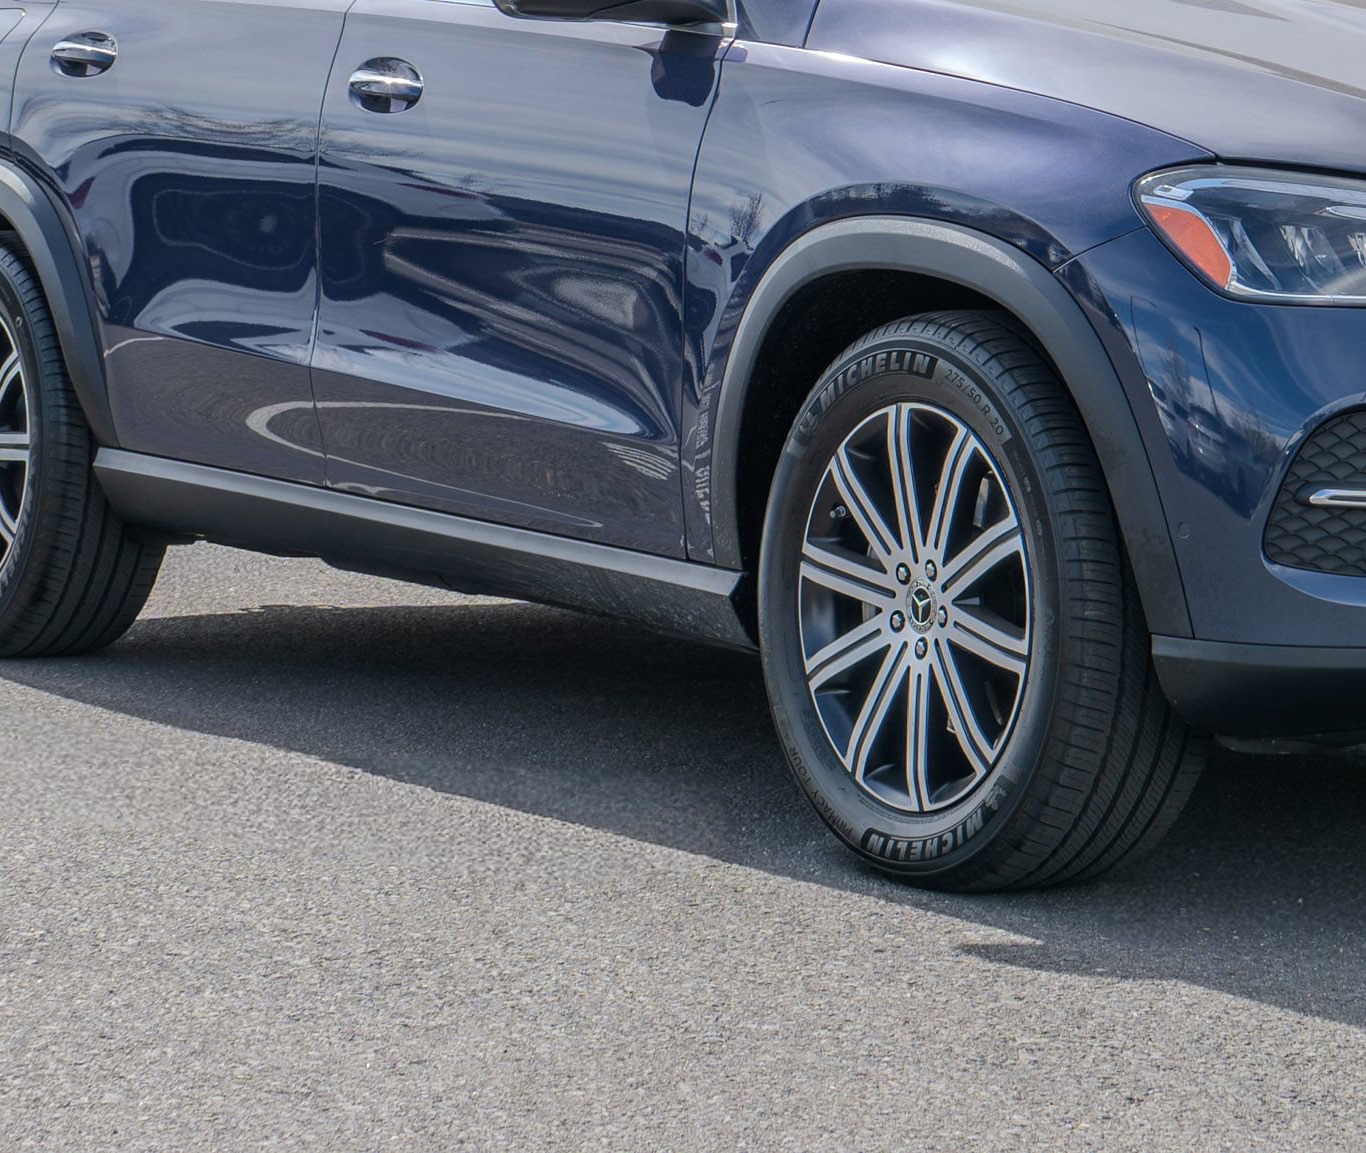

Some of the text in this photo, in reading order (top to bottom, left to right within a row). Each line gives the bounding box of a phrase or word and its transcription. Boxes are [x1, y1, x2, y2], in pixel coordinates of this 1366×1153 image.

[820, 351, 931, 412] MICHELIN
[944, 369, 1004, 436] 275/50 R 20
[789, 747, 812, 784] TOUR
[809, 789, 855, 836] PRIMACY
[866, 806, 984, 861] MICHELIN
